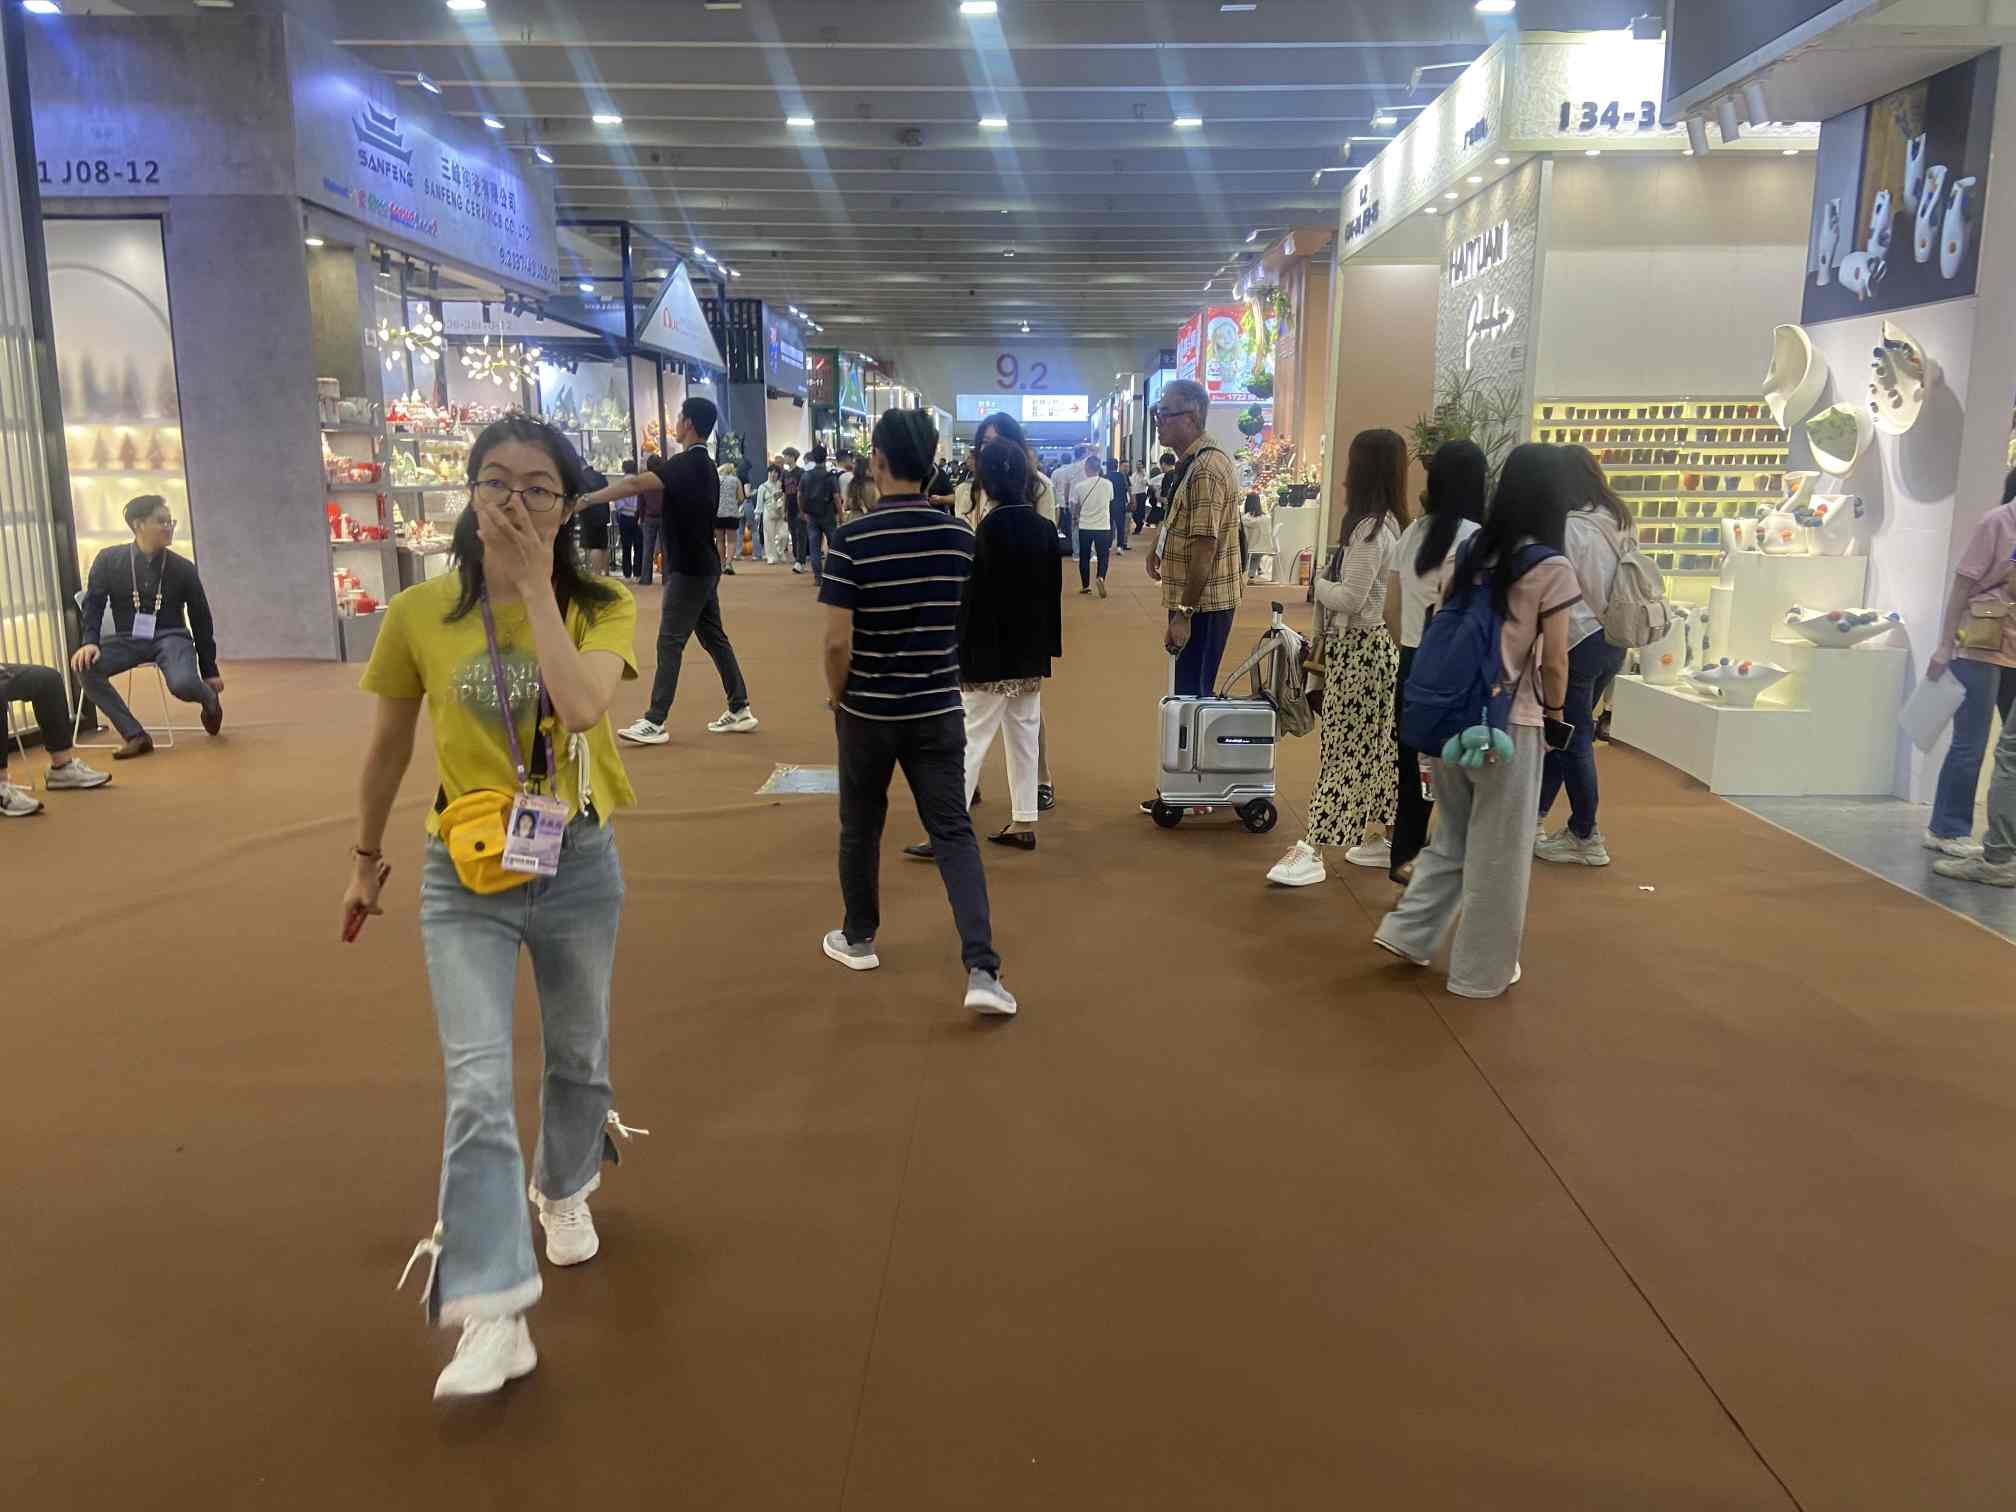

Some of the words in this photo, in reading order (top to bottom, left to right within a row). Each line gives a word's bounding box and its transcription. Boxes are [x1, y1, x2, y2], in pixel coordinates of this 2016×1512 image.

[62, 160, 159, 183] J08-12
[358, 149, 414, 188] SANFENG
[424, 178, 462, 210] SANFENG
[996, 353, 1049, 390] 9.2
